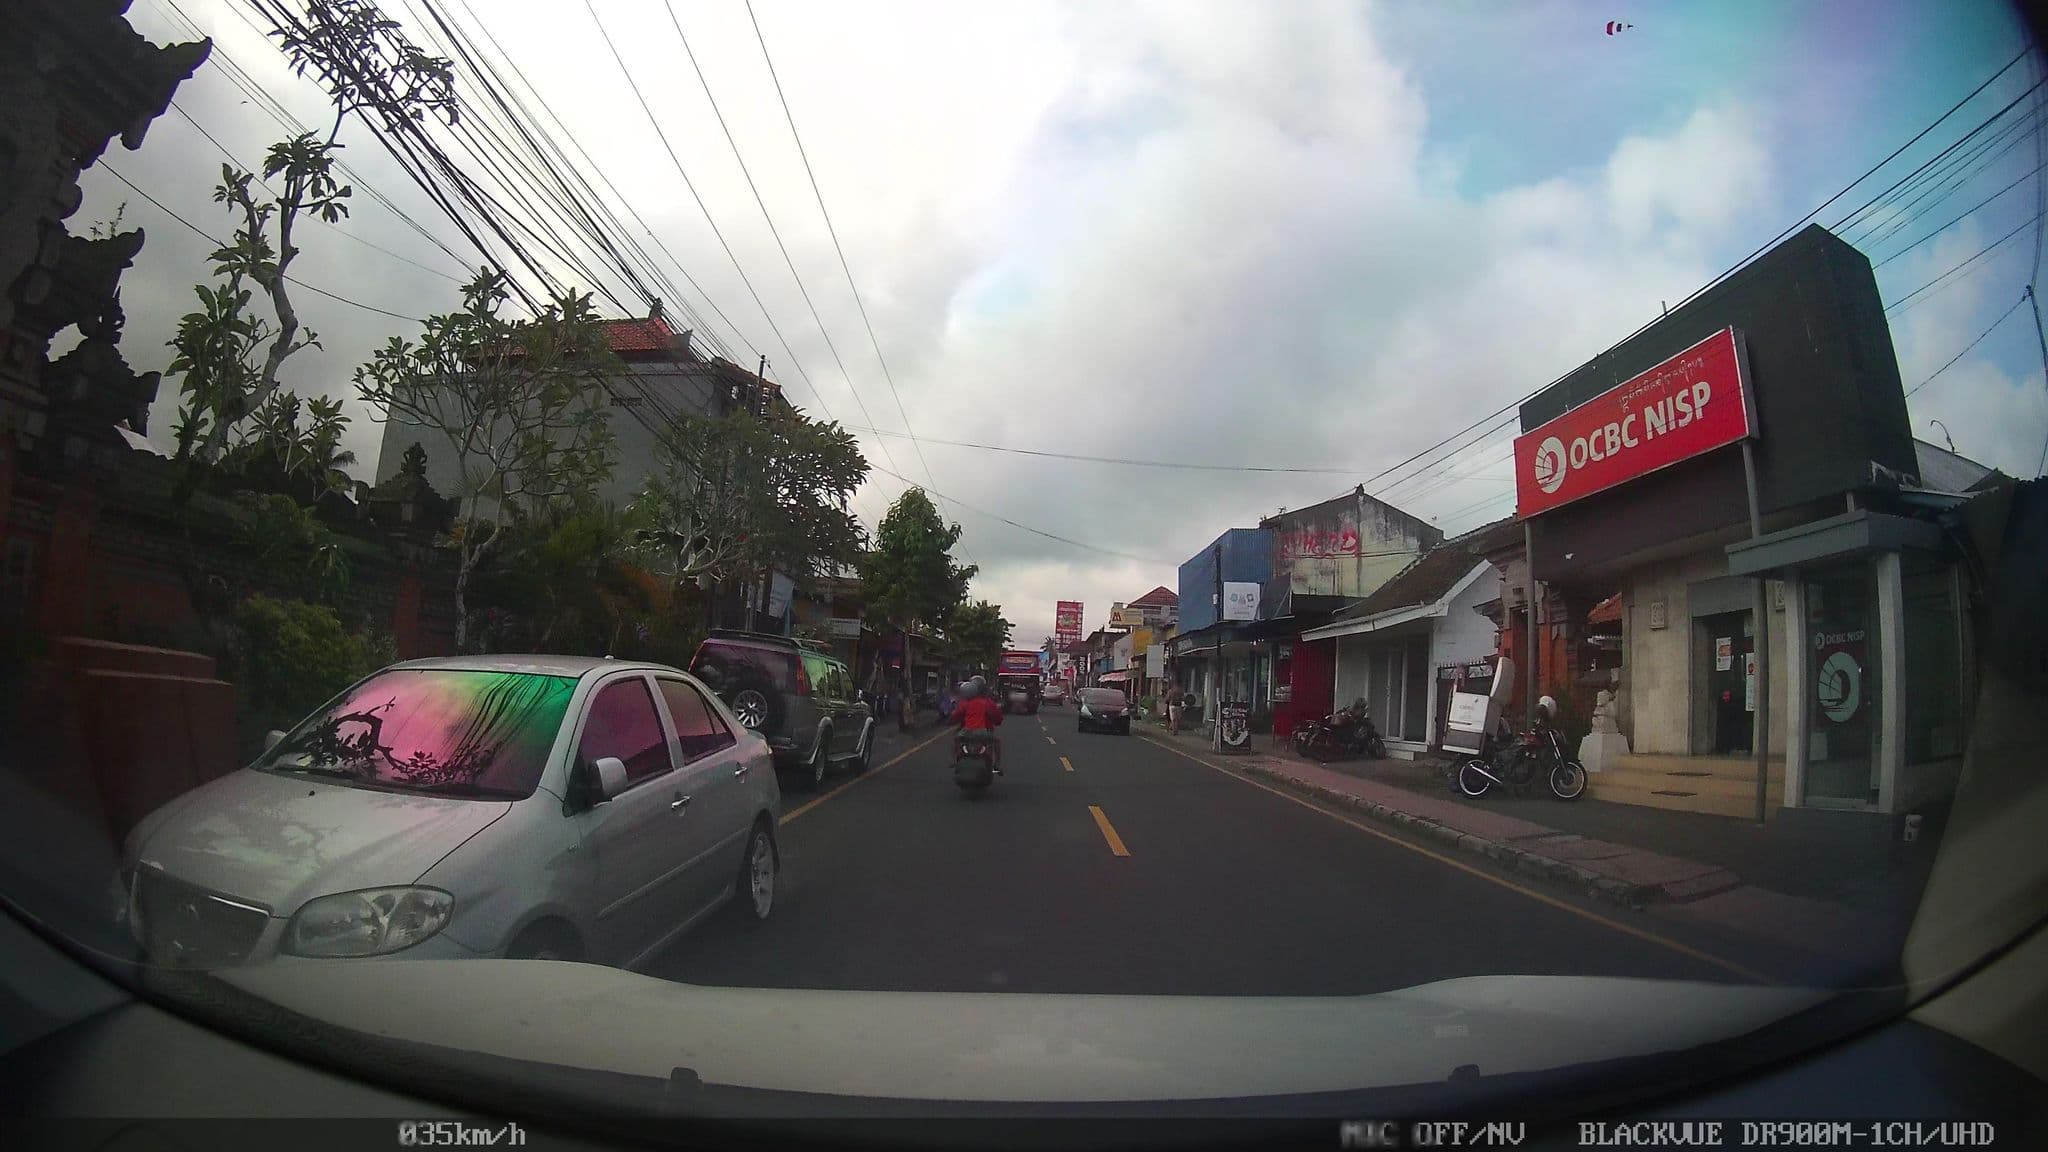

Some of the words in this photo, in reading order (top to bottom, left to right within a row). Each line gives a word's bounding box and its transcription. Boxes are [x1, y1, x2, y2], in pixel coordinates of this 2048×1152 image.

[1570, 415, 1638, 469] OCBC
[1644, 381, 1711, 440] NISP
[1826, 634, 1846, 645] OCBC
[1847, 630, 1865, 643] NISP
